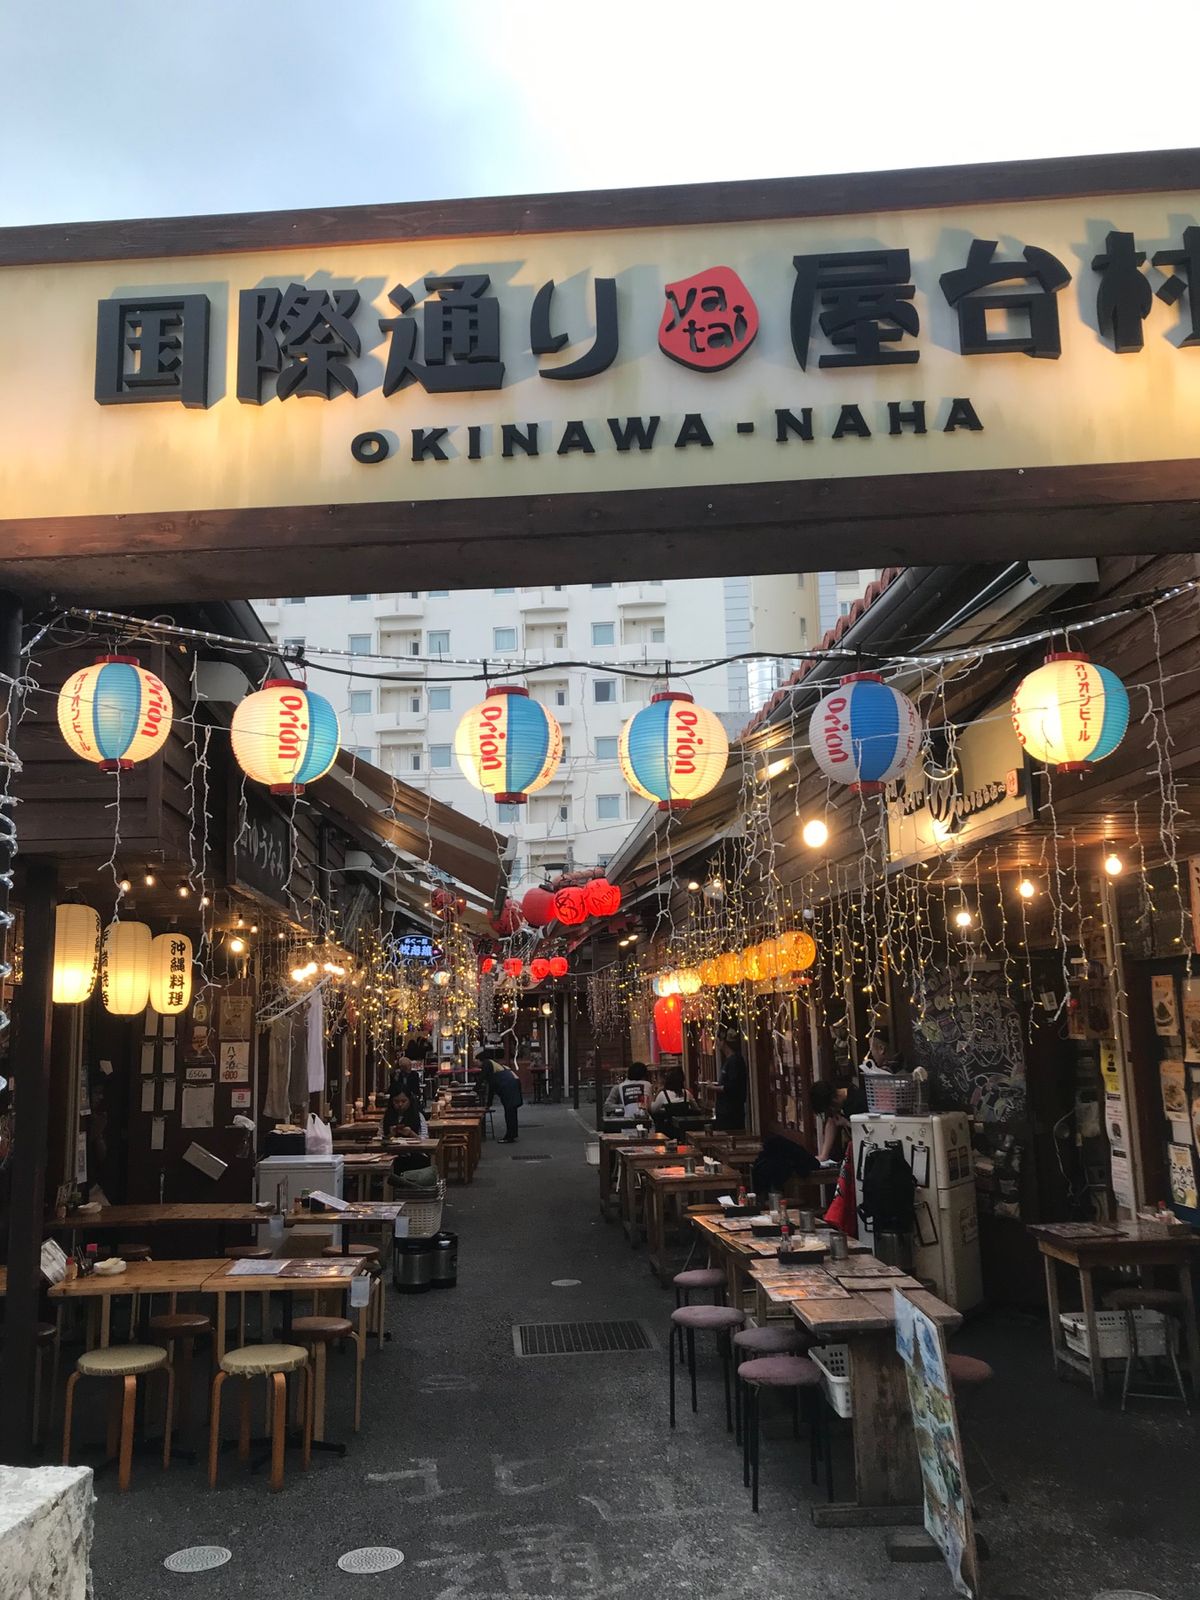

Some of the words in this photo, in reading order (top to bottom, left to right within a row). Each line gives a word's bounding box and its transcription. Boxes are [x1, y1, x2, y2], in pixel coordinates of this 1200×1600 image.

[665, 283, 728, 333] ya
[683, 306, 748, 353] tai
[95, 274, 619, 409] 国際通り
[70, 672, 91, 752] オリオンビール
[141, 675, 168, 738] Orion
[277, 695, 308, 760] Orion
[824, 697, 850, 764] Orion
[1074, 664, 1092, 742] オリオンビール
[479, 706, 506, 772] Orion
[674, 710, 704, 775] Orion
[168, 940, 187, 1006] 沖縄料理
